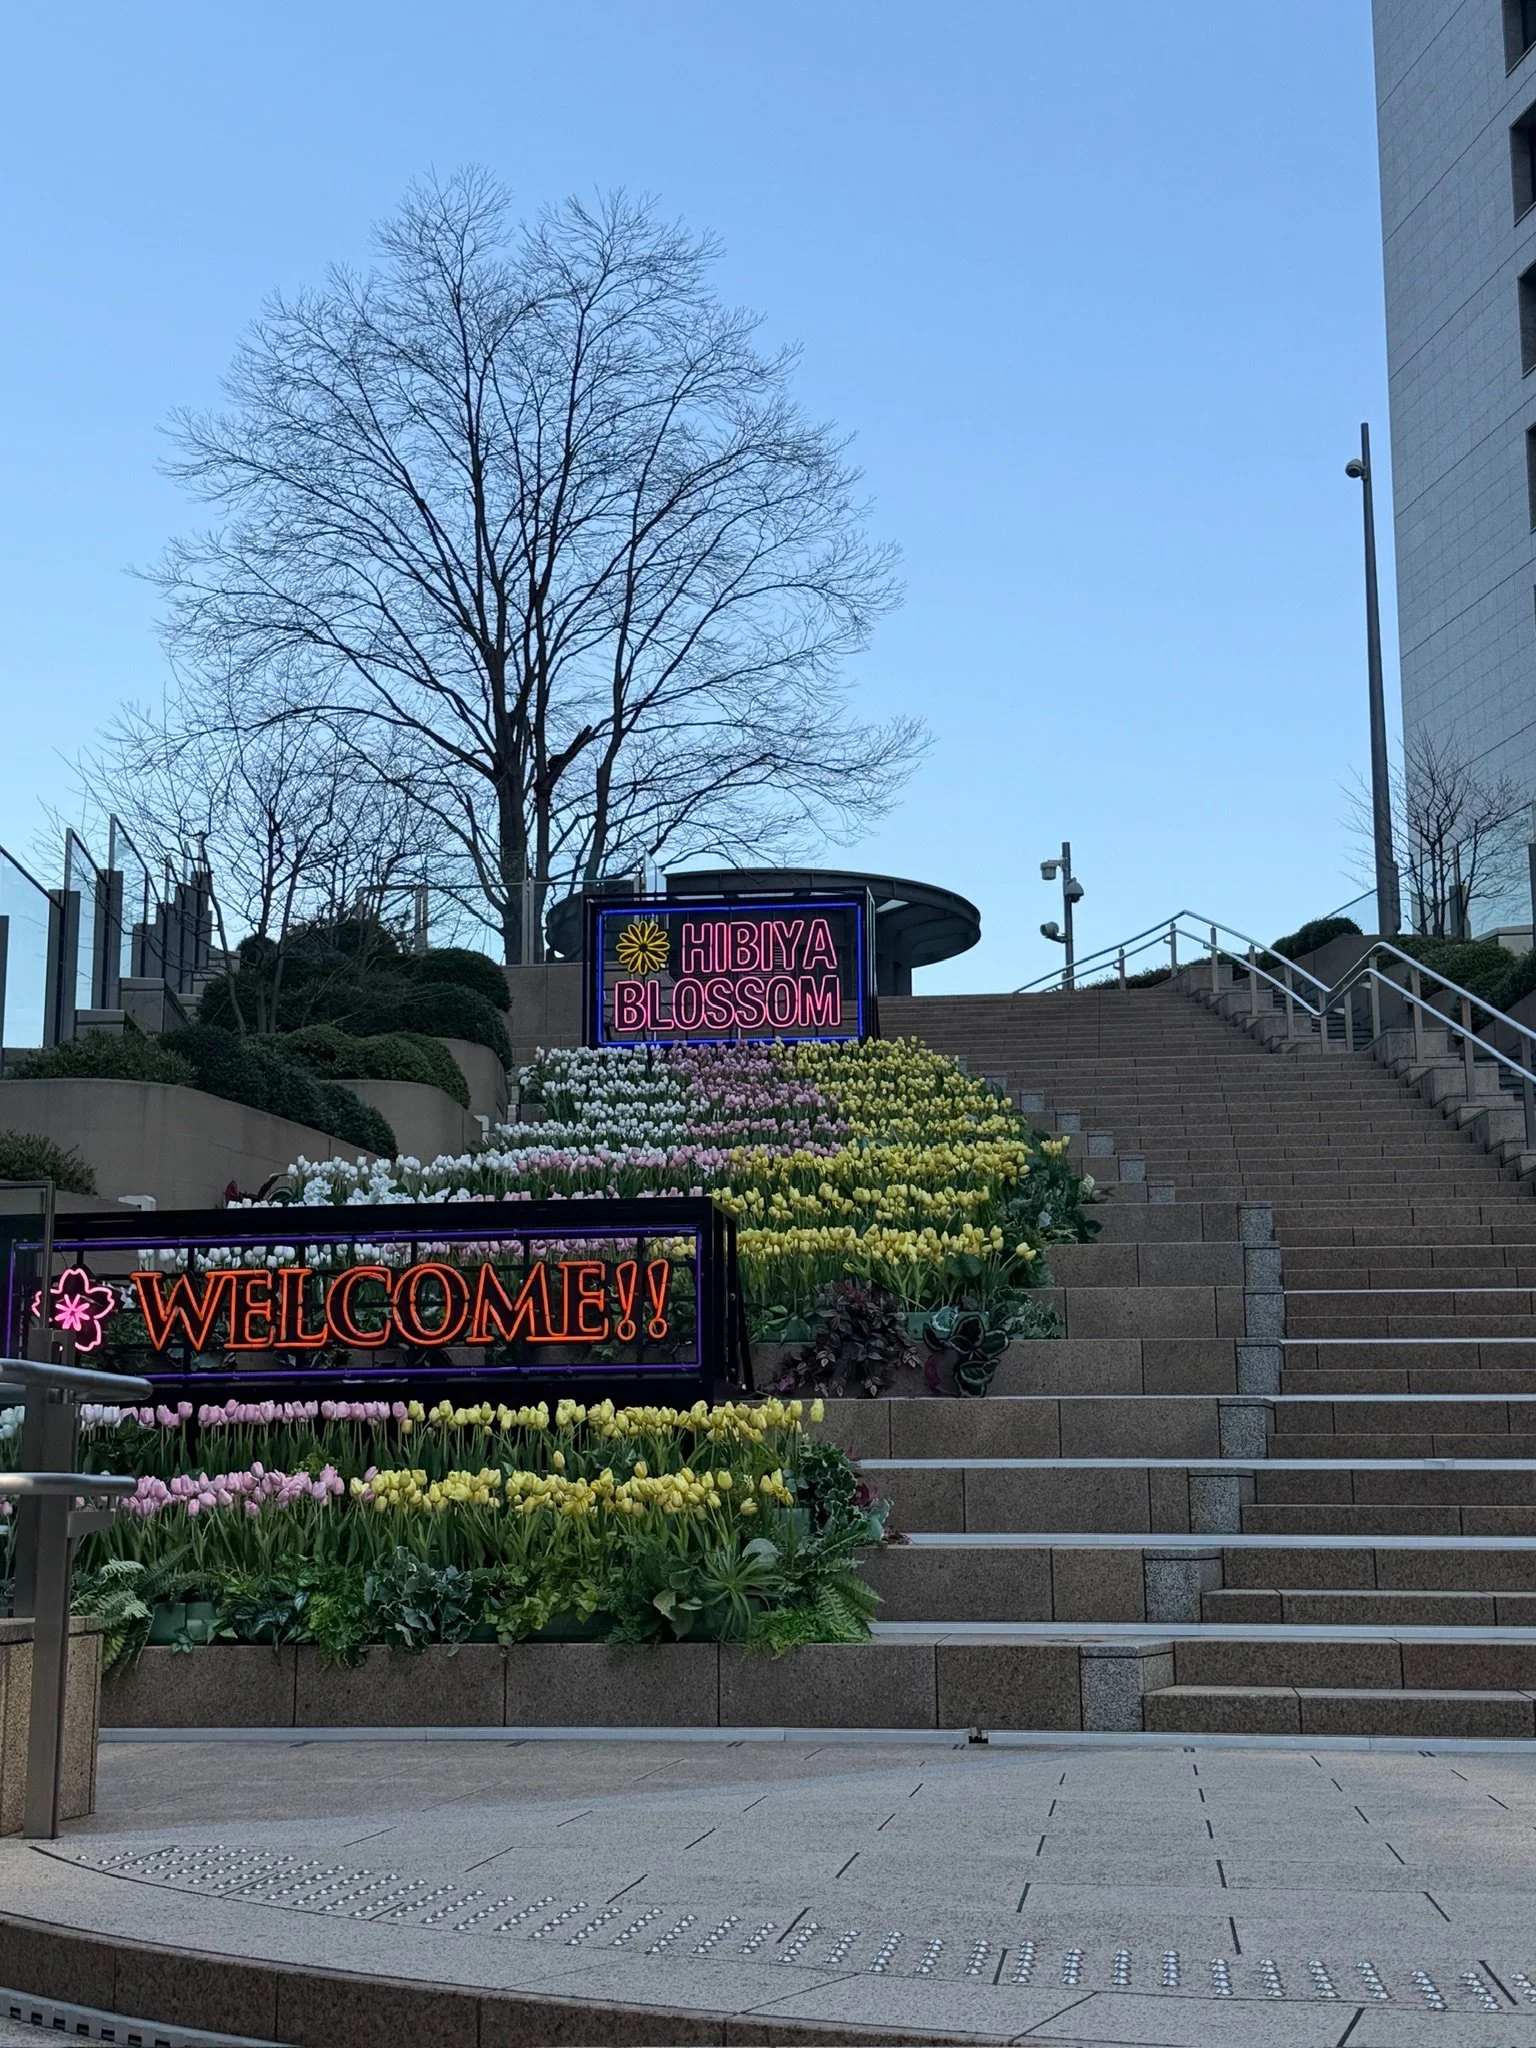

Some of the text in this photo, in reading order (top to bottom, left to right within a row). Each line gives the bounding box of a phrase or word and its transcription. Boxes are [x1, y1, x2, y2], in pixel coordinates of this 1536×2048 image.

[681, 918, 838, 974] HIBIYA
[614, 974, 841, 1032] BLOSSOM
[130, 1258, 674, 1351] WELCOME!!
